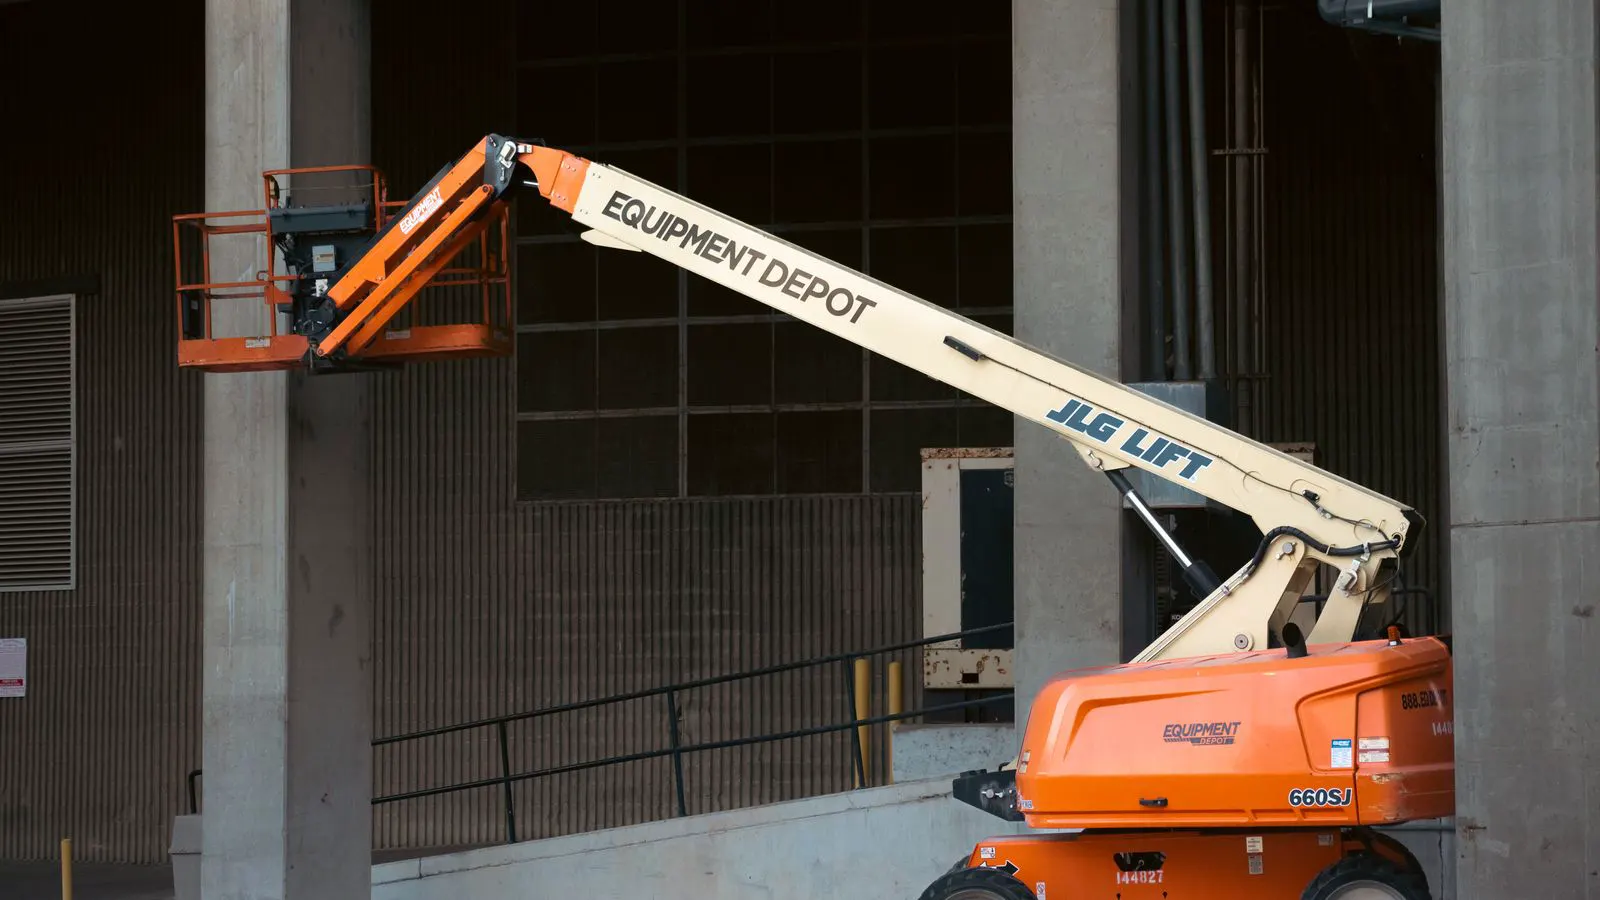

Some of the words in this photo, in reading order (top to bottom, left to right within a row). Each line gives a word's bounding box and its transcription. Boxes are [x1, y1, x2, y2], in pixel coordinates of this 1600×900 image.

[601, 190, 767, 276] EQUIPMENT
[758, 258, 878, 325] DEPOT
[1046, 398, 1125, 444] JLG
[1119, 427, 1214, 480] LIFT
[1163, 721, 1241, 738] EQUIPMENT
[1200, 736, 1227, 745] DEPOT
[1289, 788, 1352, 807] 660SJ
[1116, 869, 1164, 884] 144827
